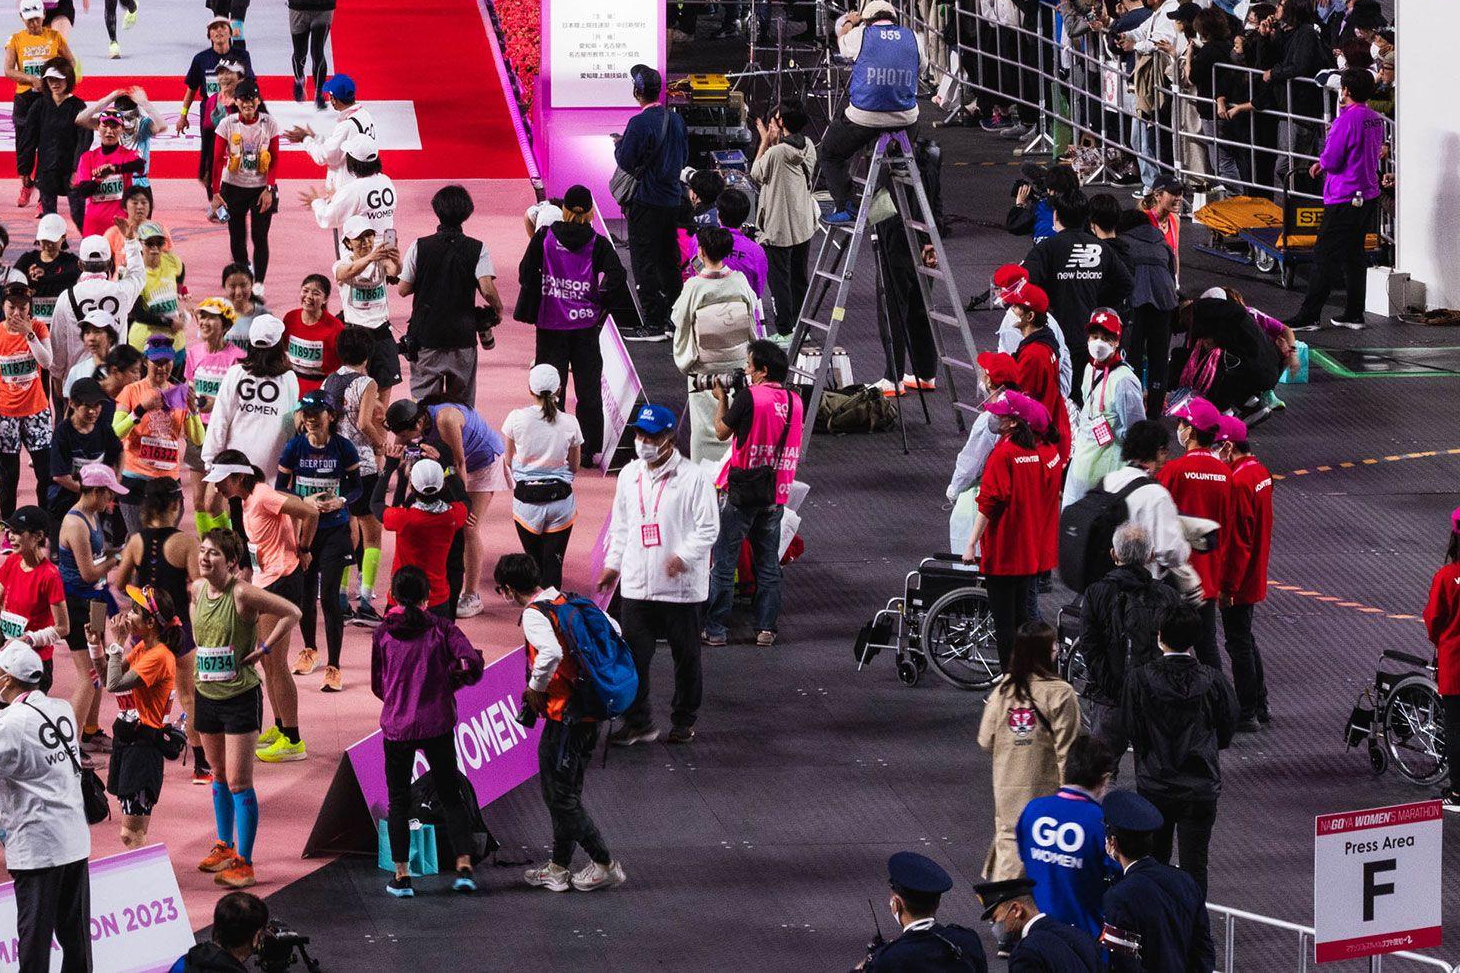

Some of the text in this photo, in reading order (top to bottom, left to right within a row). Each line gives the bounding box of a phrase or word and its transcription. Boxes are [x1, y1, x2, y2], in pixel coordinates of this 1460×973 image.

[866, 67, 914, 86] PHOTO
[366, 187, 394, 208] GO
[367, 209, 394, 220] WOMEN
[541, 274, 591, 292] SPONSOR
[1057, 270, 1102, 280] new balanc
[569, 308, 594, 320] 068
[239, 379, 280, 403] GO
[239, 404, 278, 417] WOMEN
[749, 444, 800, 459] OFFIAL
[1185, 471, 1227, 482] VOLUNTEER
[39, 716, 74, 751] GO
[44, 746, 80, 768] WOME
[1320, 805, 1440, 832] NAGOYA WOMEN'S MARATHON
[1032, 816, 1085, 852] GO
[1345, 834, 1415, 855] Press Area
[1030, 847, 1083, 869] WOMEN
[1362, 858, 1397, 922] F
[123, 897, 178, 932] 2023
